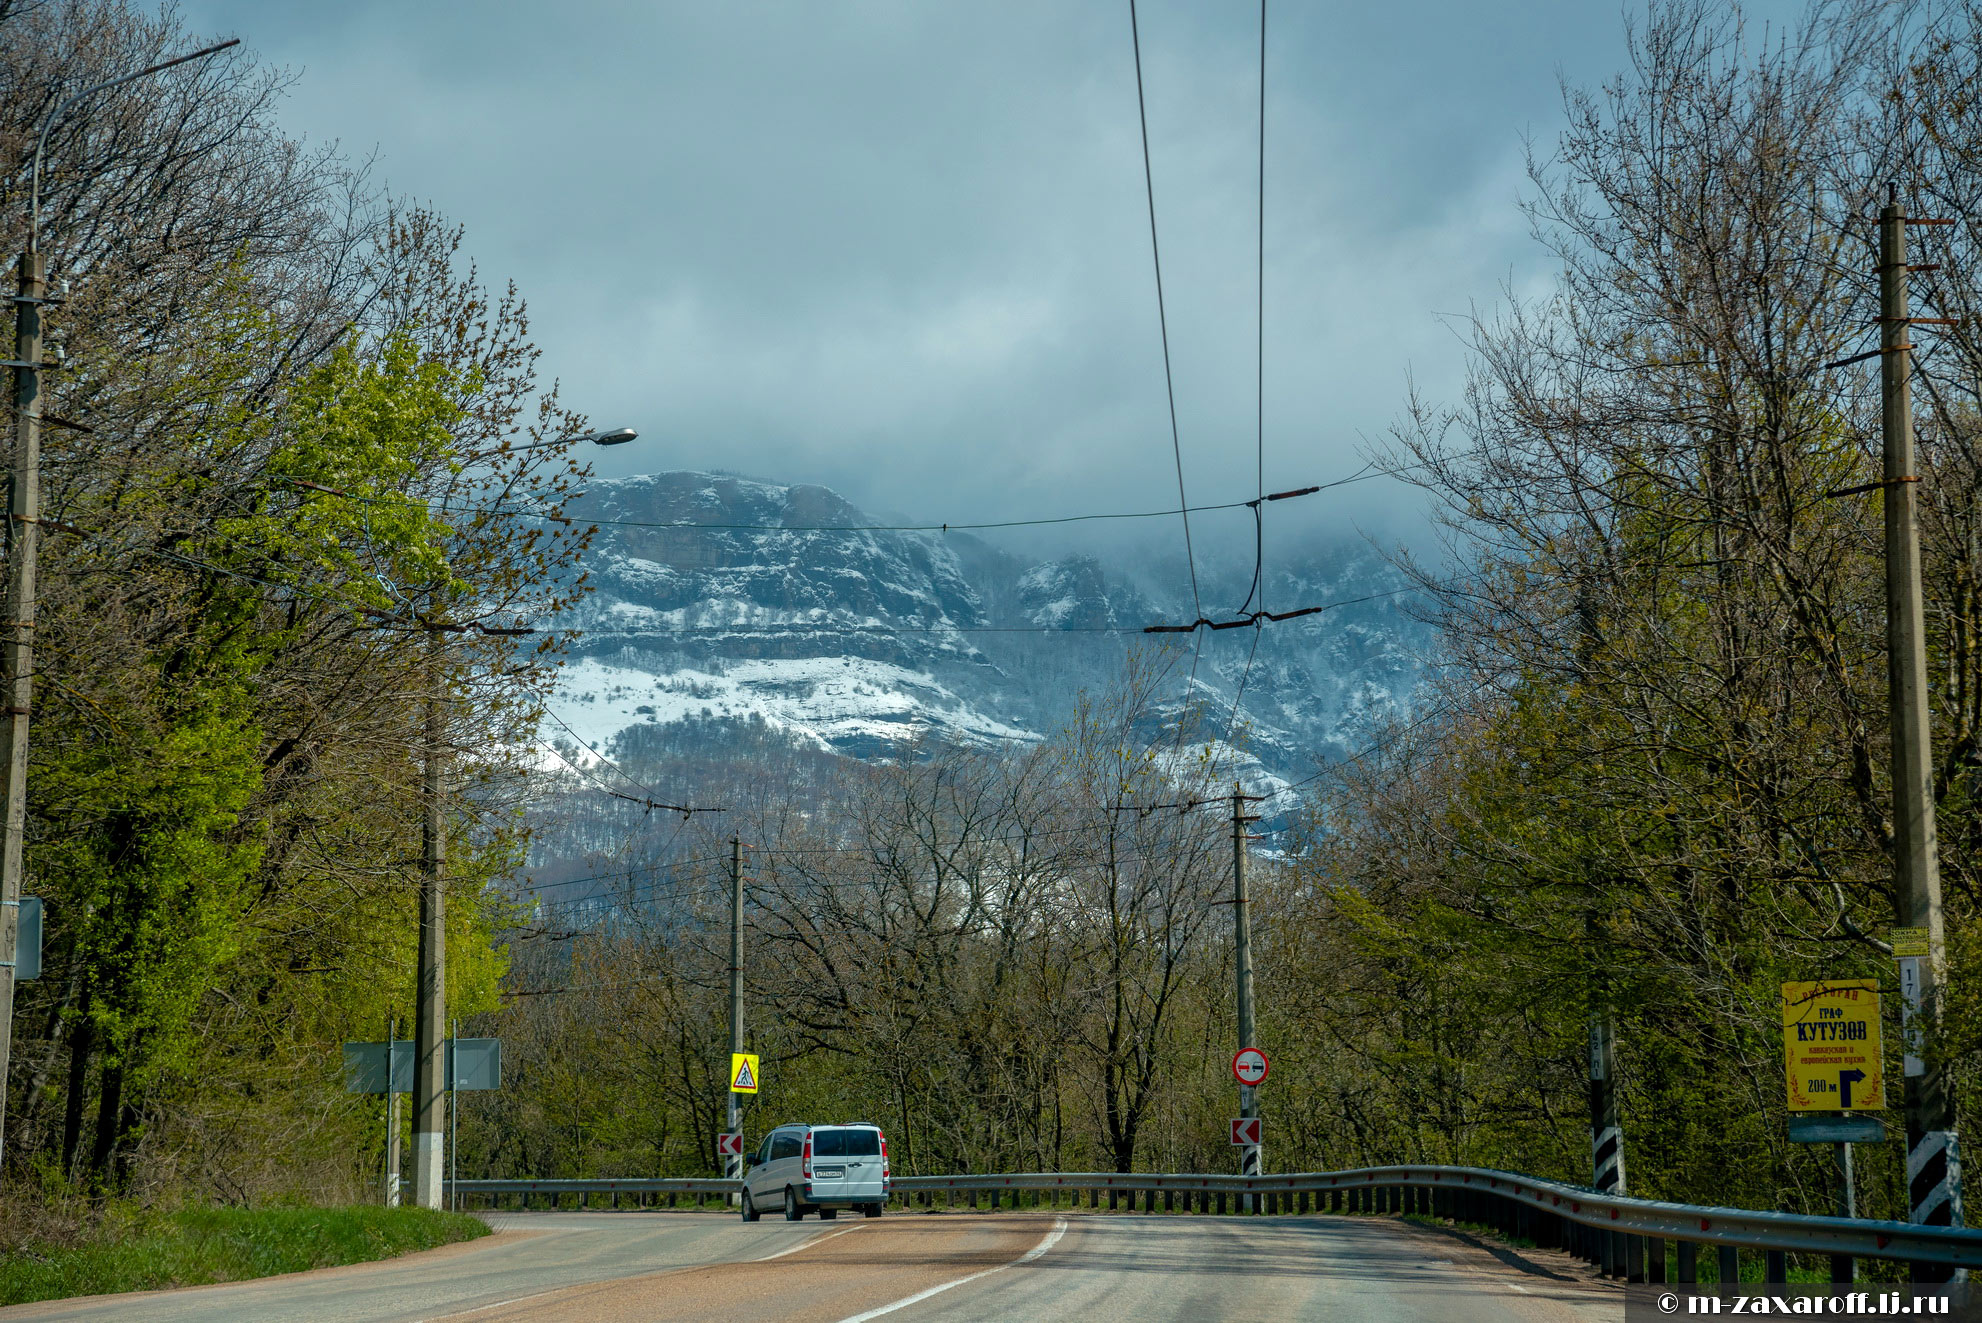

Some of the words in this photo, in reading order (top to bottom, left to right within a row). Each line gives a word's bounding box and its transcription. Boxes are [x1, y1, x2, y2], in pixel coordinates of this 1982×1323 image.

[1819, 1007, 1843, 1019] ГРАФ
[1797, 1021, 1867, 1041] КУТУЗОВ
[1808, 1079, 1826, 1092] 200
[1828, 1083, 1837, 1092] м
